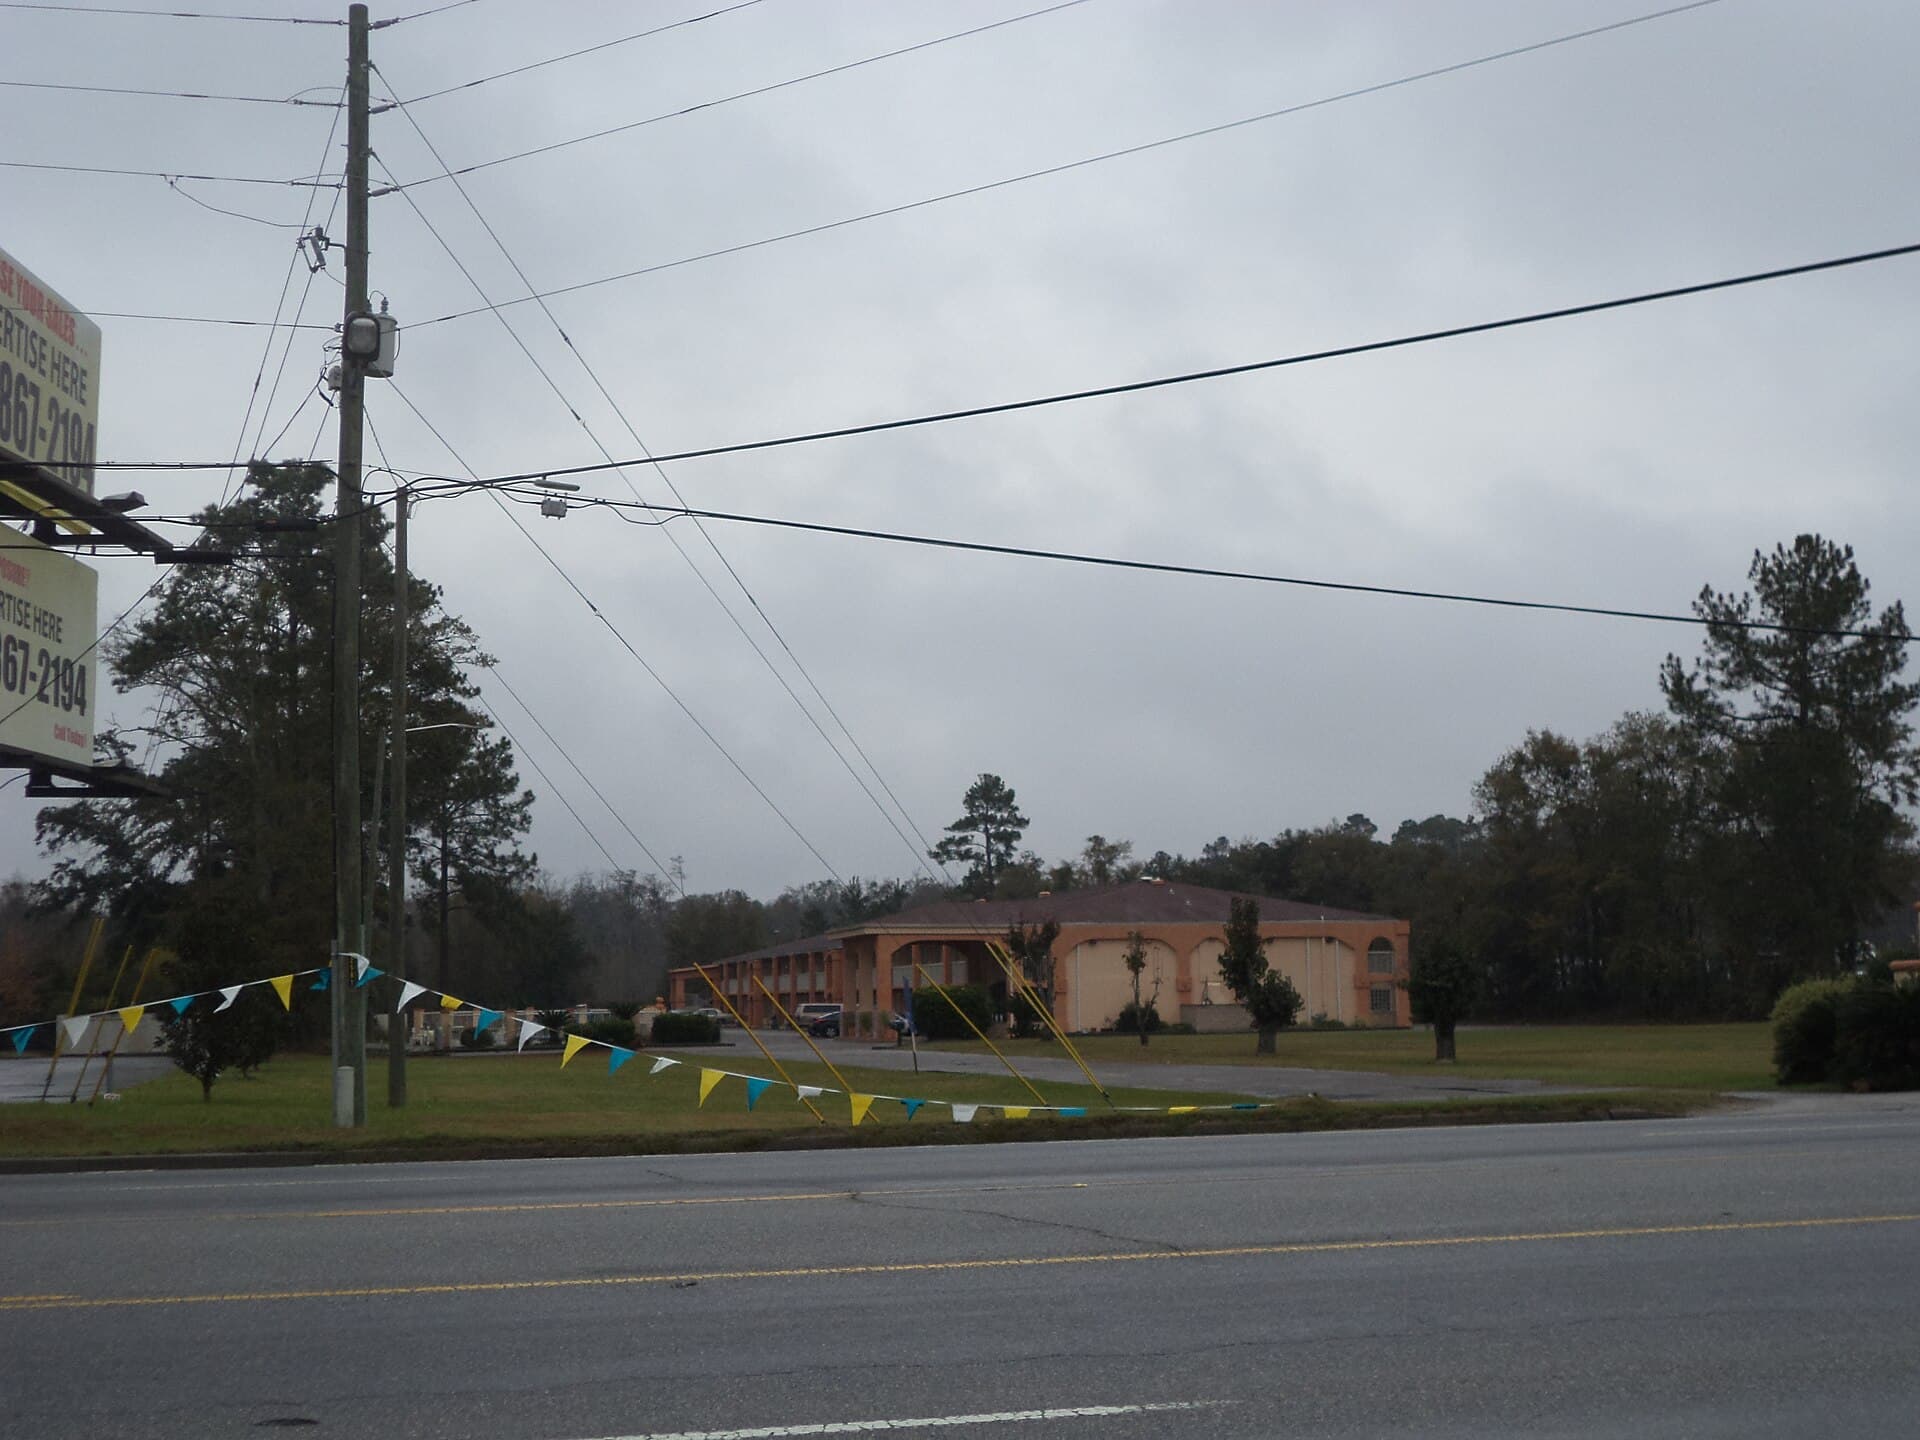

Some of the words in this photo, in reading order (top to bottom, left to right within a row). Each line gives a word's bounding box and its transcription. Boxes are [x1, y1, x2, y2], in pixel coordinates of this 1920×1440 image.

[16, 271, 44, 323] YOUR
[51, 346, 88, 407] HERE
[0, 361, 95, 497] 867-2194
[33, 605, 62, 644] HERE
[0, 632, 86, 717] 67-2194
